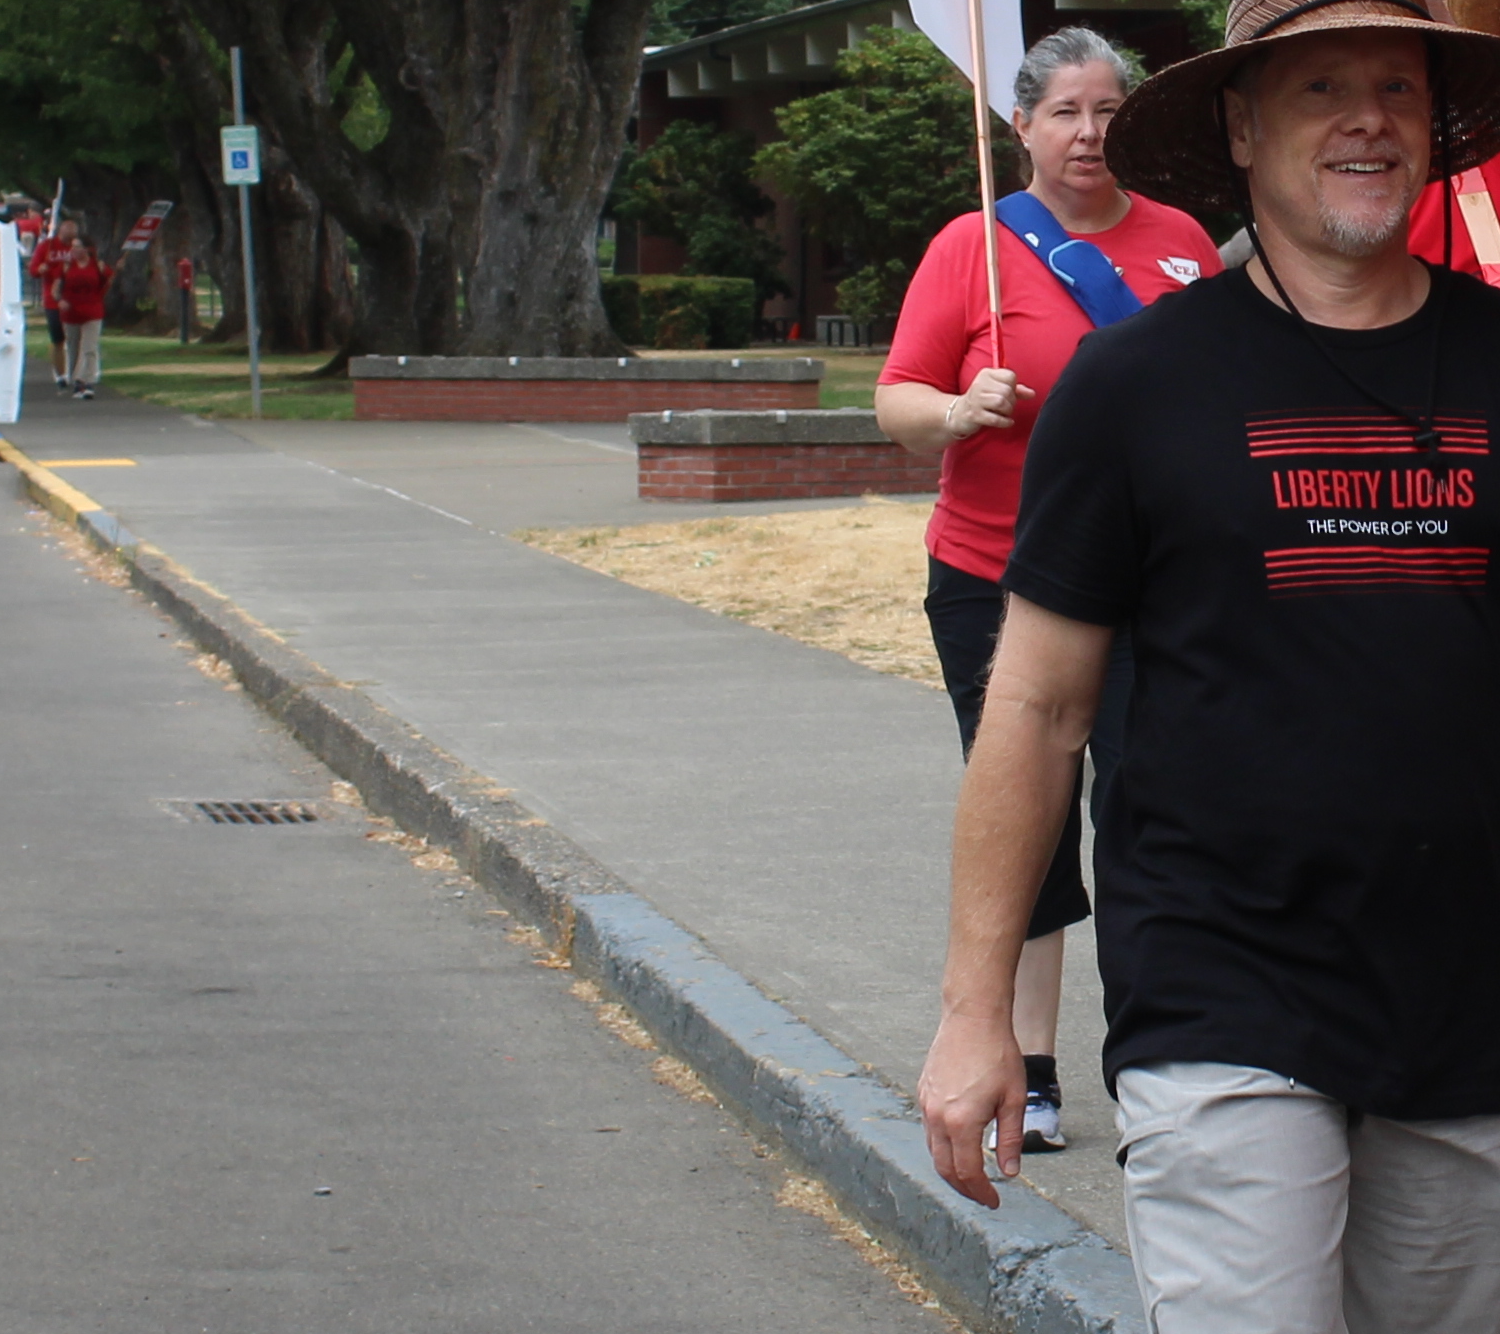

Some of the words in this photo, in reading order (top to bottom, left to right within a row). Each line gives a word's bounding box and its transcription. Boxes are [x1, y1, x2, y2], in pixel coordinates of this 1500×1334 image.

[1272, 469, 1381, 510] LIBERTY
[1390, 468, 1476, 509] LIONS
[1307, 519, 1337, 534] THE
[1340, 519, 1389, 536] POWER
[1391, 520, 1413, 535] OF
[1415, 519, 1449, 535] YOU
